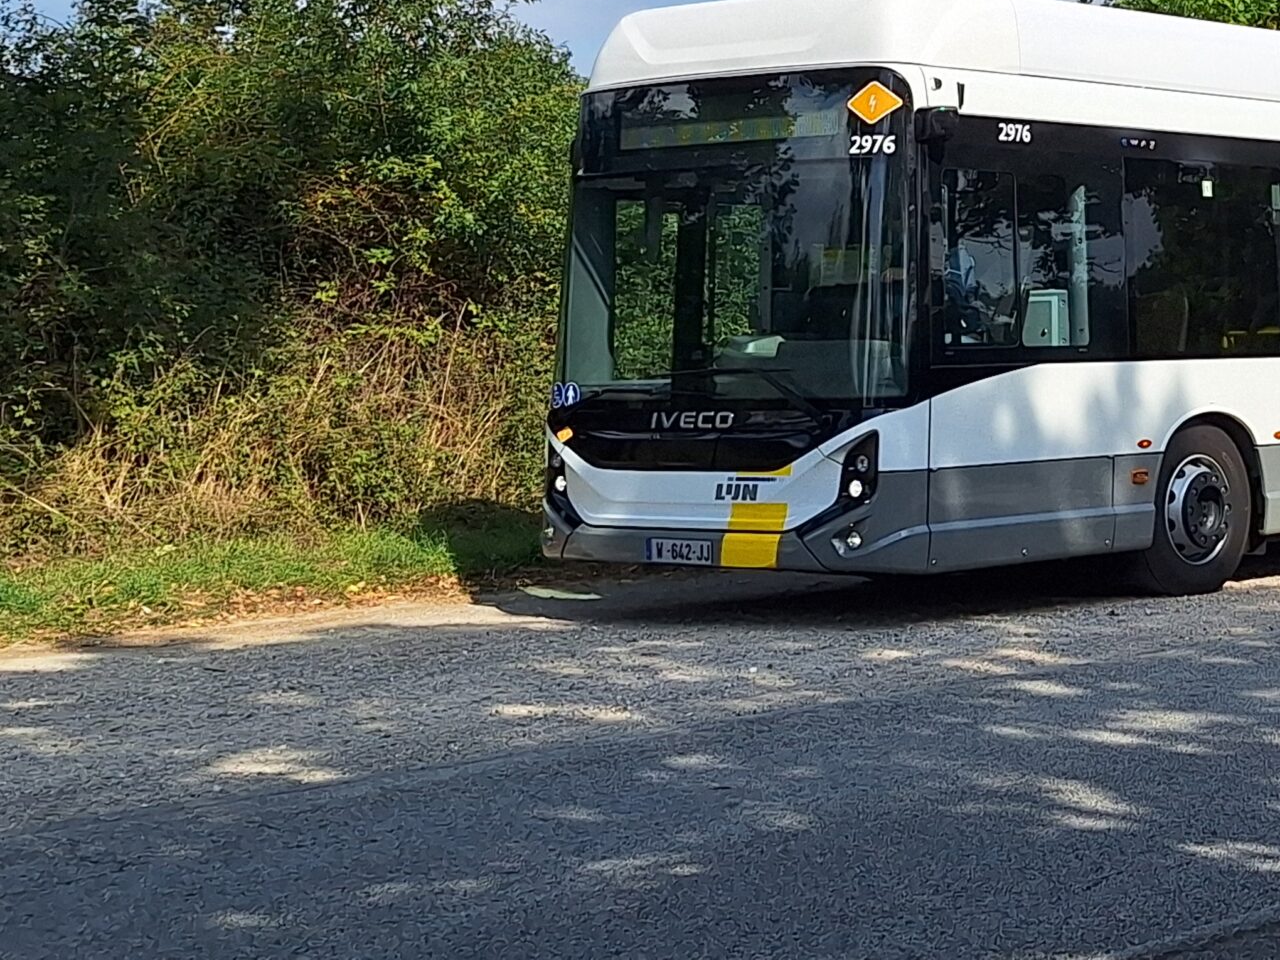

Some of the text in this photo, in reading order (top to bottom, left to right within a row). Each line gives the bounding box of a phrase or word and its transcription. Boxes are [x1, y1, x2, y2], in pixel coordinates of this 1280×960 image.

[998, 123, 1032, 143] 2976
[848, 134, 896, 154] 2976
[650, 411, 734, 429] IVECO
